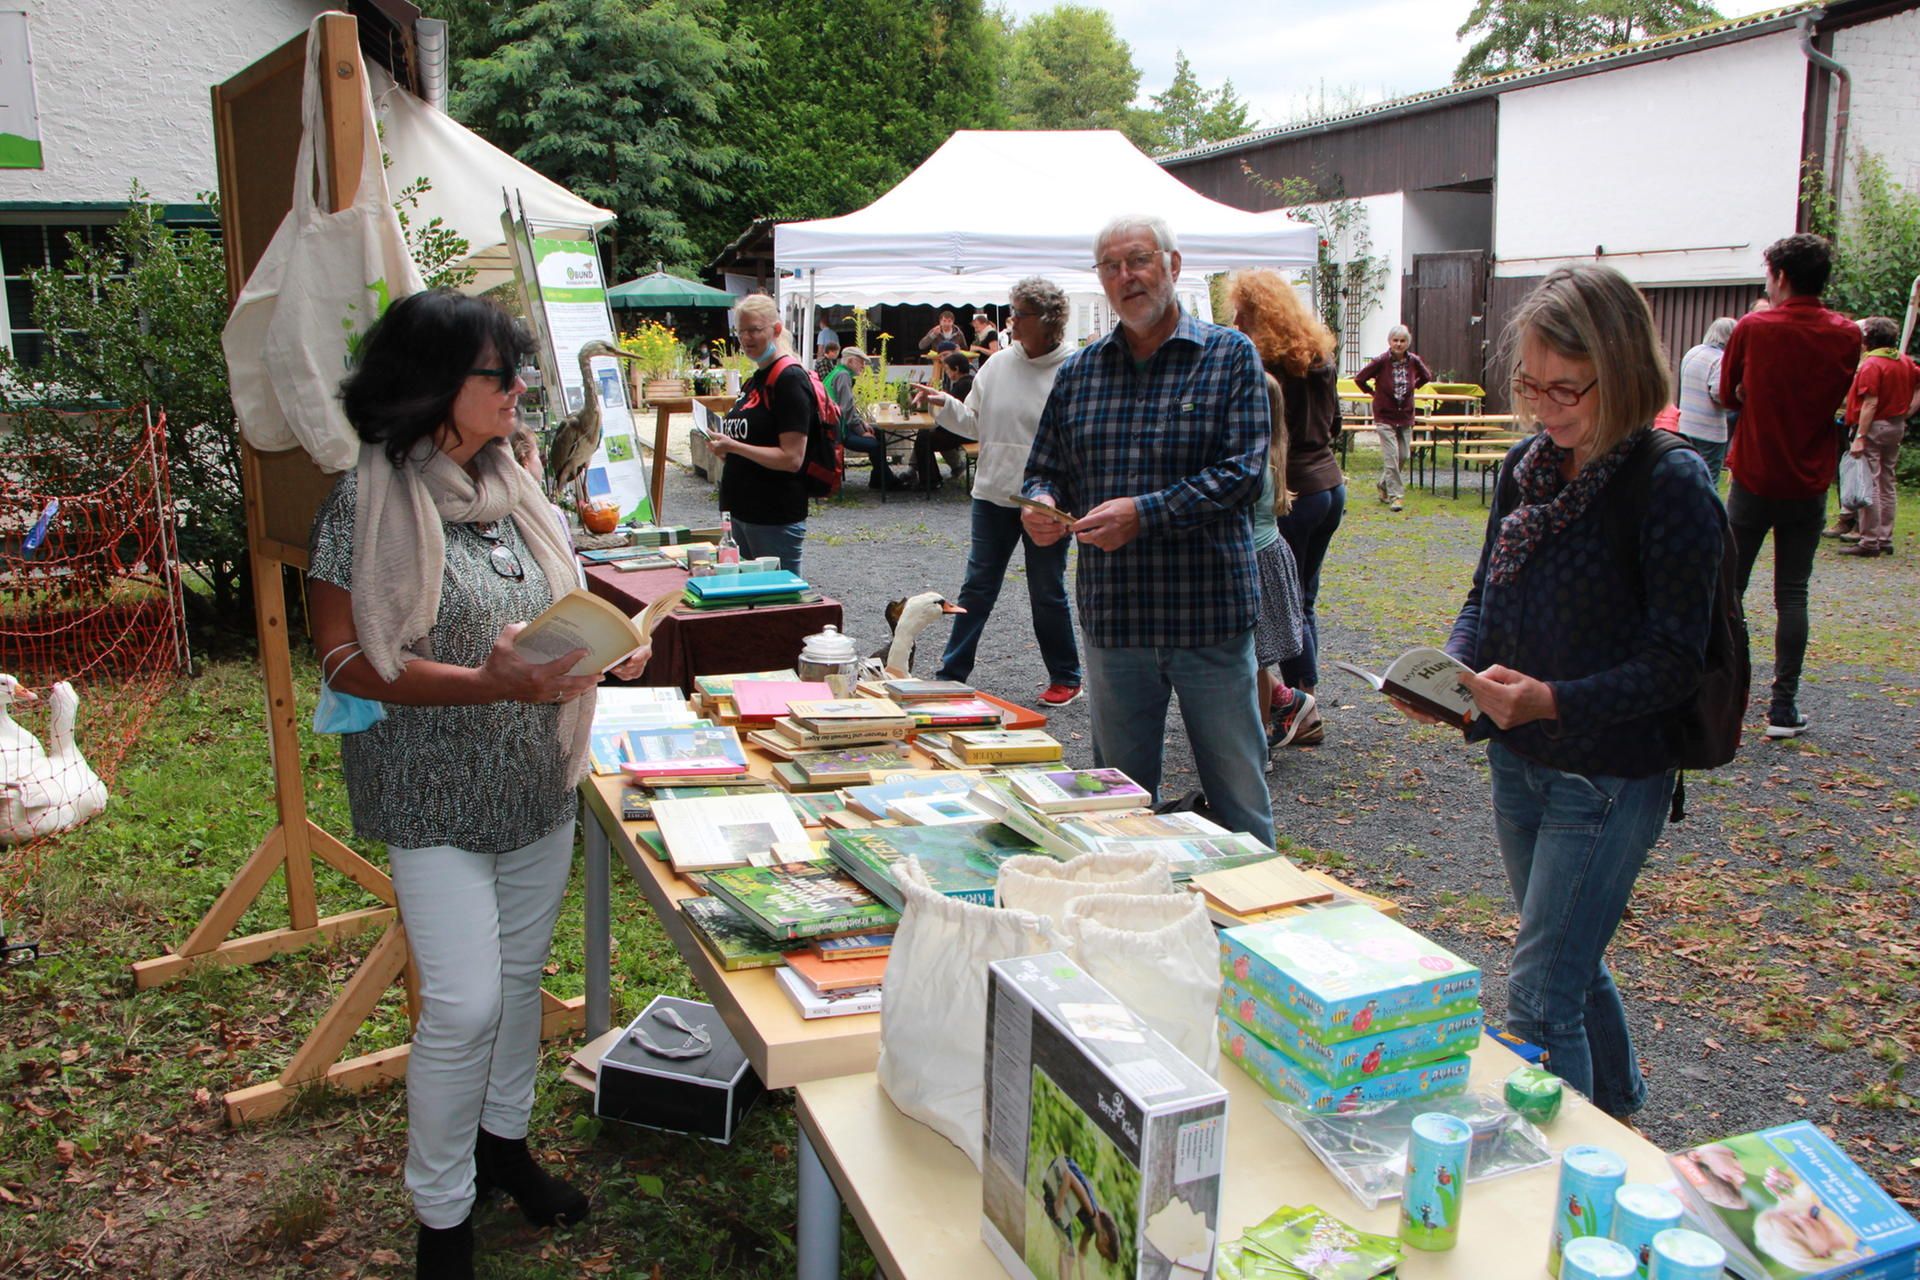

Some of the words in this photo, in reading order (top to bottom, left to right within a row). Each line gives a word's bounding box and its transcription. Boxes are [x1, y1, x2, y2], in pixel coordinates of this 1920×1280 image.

[575, 271, 593, 279] BUND
[1121, 1118, 1139, 1145] Kids
[1791, 1138, 1860, 1204] Becherlupe
